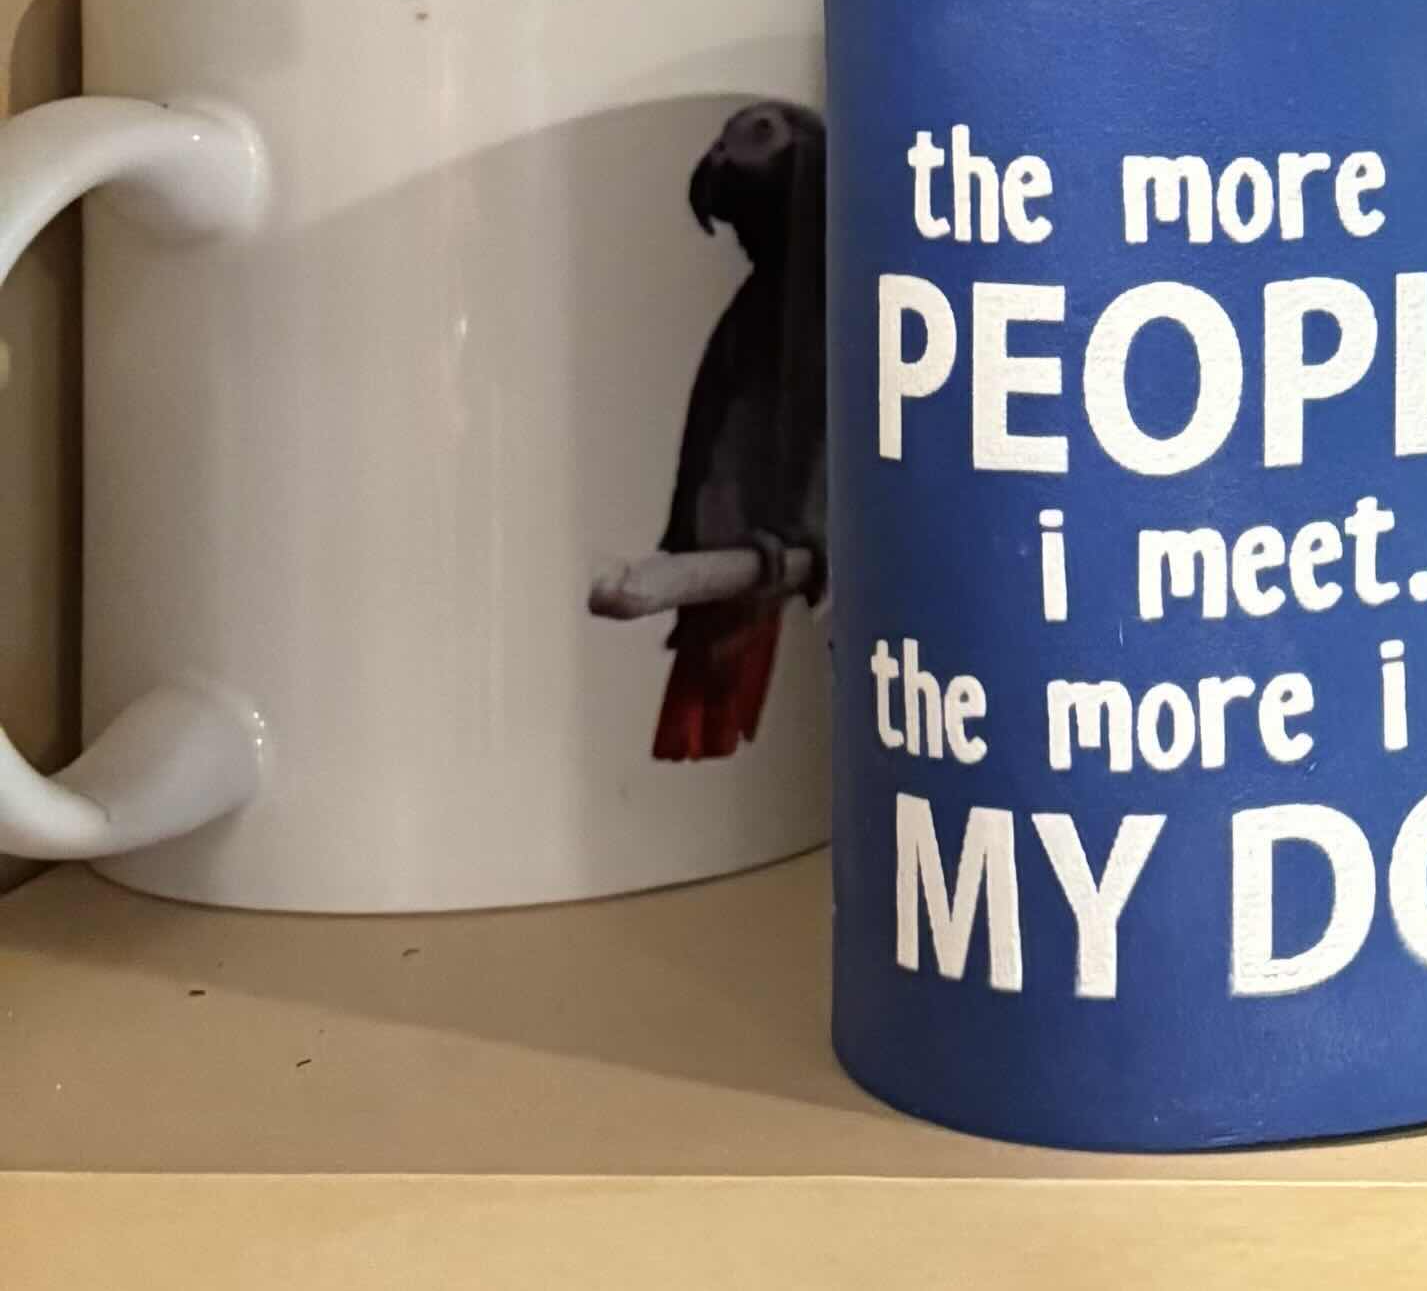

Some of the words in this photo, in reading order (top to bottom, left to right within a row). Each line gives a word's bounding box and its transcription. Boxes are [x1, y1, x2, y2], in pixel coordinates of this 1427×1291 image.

[907, 123, 1054, 245] the
[1121, 150, 1387, 245] more
[1038, 508, 1068, 622] i
[870, 637, 988, 764] the
[1046, 671, 1315, 773] more
[1380, 639, 1409, 753] i
[896, 792, 1168, 999] MY
